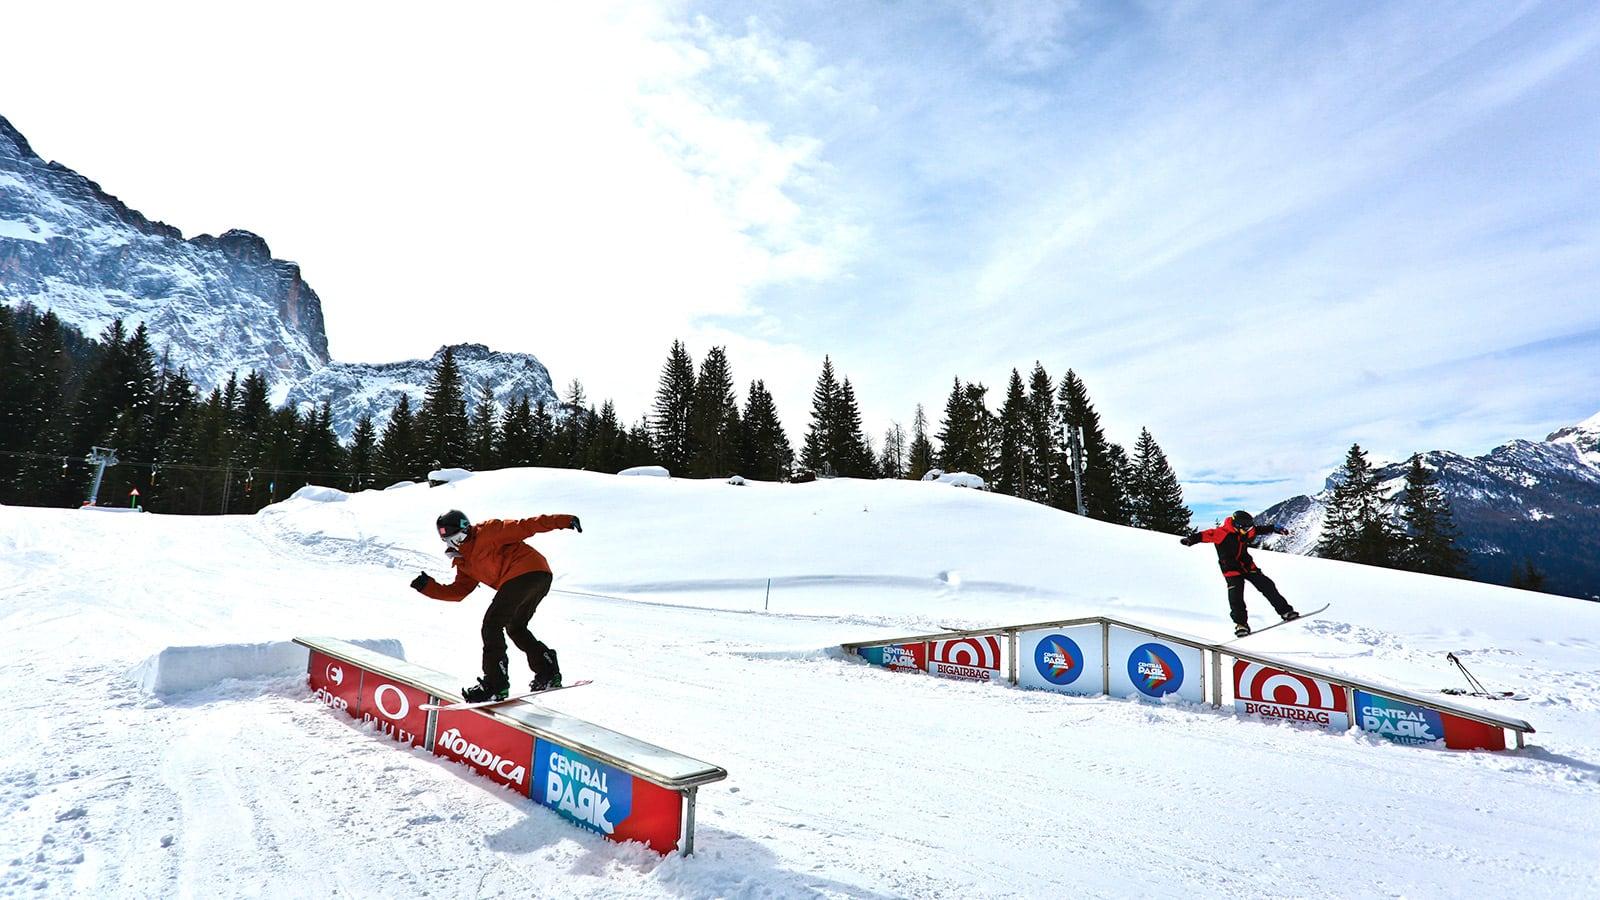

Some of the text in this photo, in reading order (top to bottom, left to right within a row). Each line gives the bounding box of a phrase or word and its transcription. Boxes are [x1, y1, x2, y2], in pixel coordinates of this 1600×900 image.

[882, 653, 918, 669] PARK
[883, 646, 914, 657] CENTRAL
[937, 664, 990, 680] BIGAIRBAG
[1245, 702, 1330, 725] BIGAIRBAG
[1362, 706, 1426, 722] CENTRAL
[1362, 715, 1437, 740] PARK
[438, 728, 526, 785] NORDICA
[549, 752, 608, 794] CENTRAL
[546, 770, 615, 834] PARK
